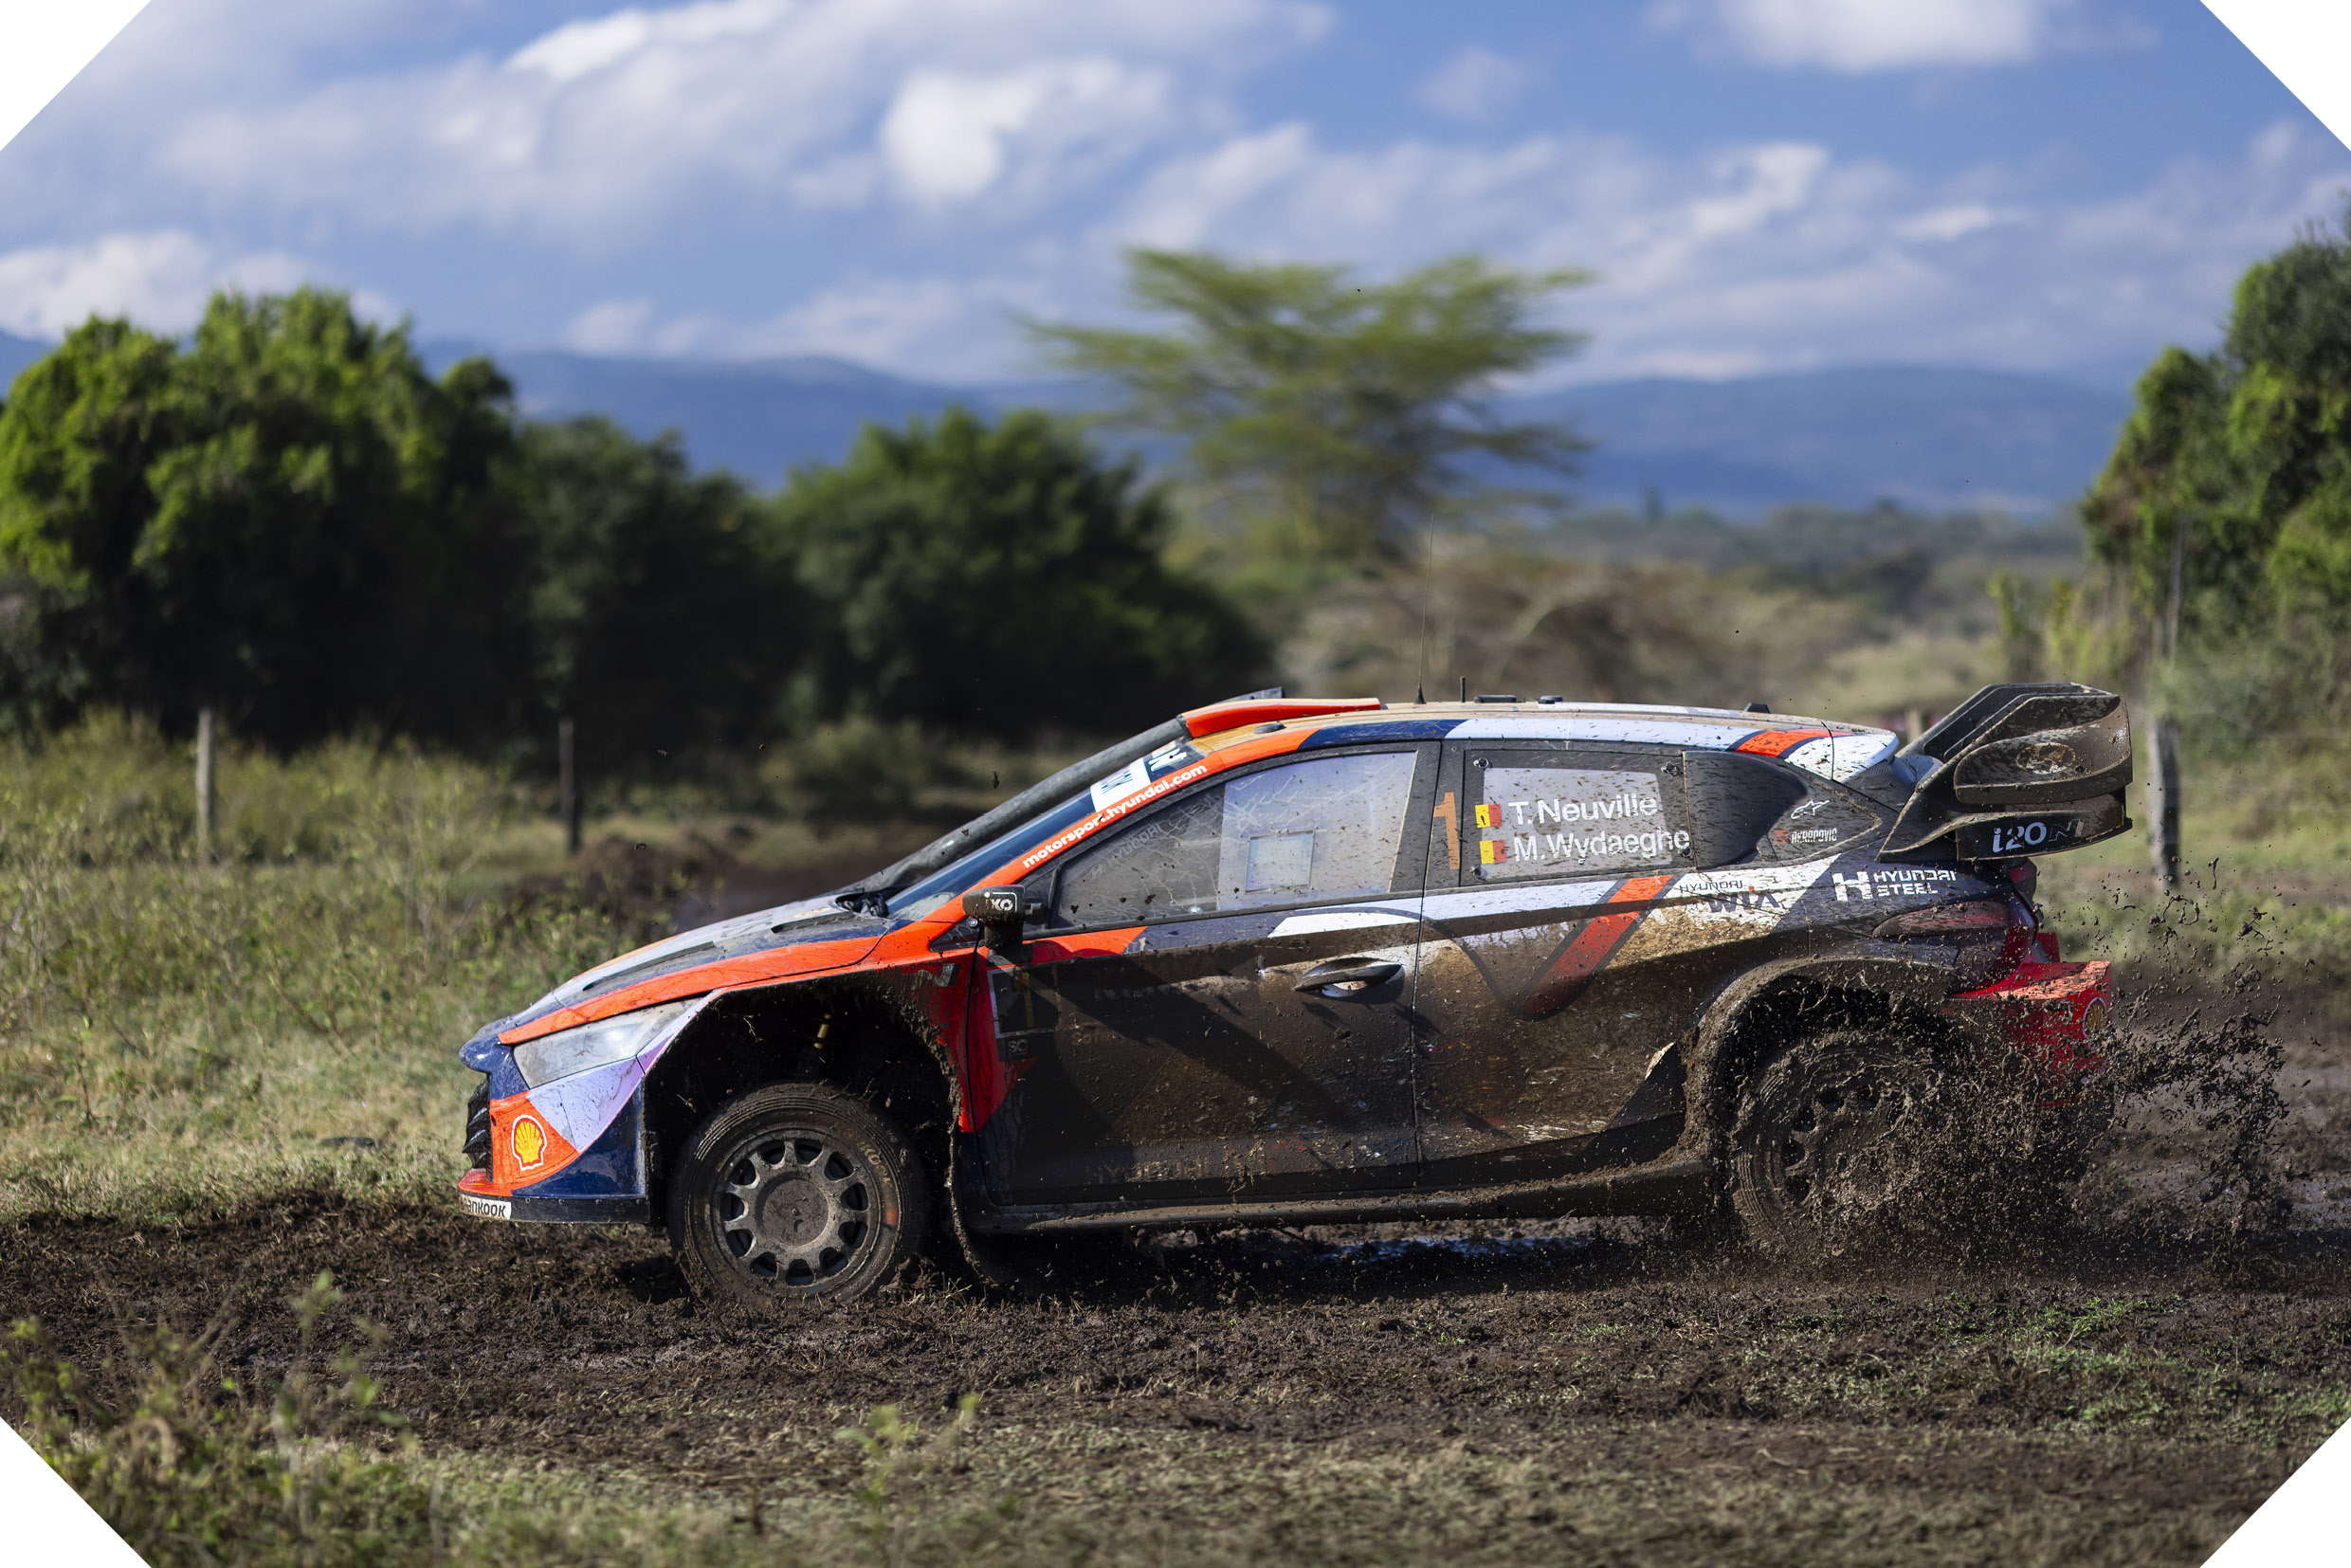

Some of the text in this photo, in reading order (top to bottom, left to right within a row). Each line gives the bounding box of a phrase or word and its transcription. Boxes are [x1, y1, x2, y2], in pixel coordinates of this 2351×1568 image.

[1022, 764, 1208, 868] motorsport.hyundai.com
[1538, 793, 1659, 824] Neuville
[1432, 792, 1461, 870] 1
[1679, 880, 1743, 892] HYUNDAI
[1873, 869, 1957, 883] HYUNDAI
[1877, 882, 1939, 897] STEEL
